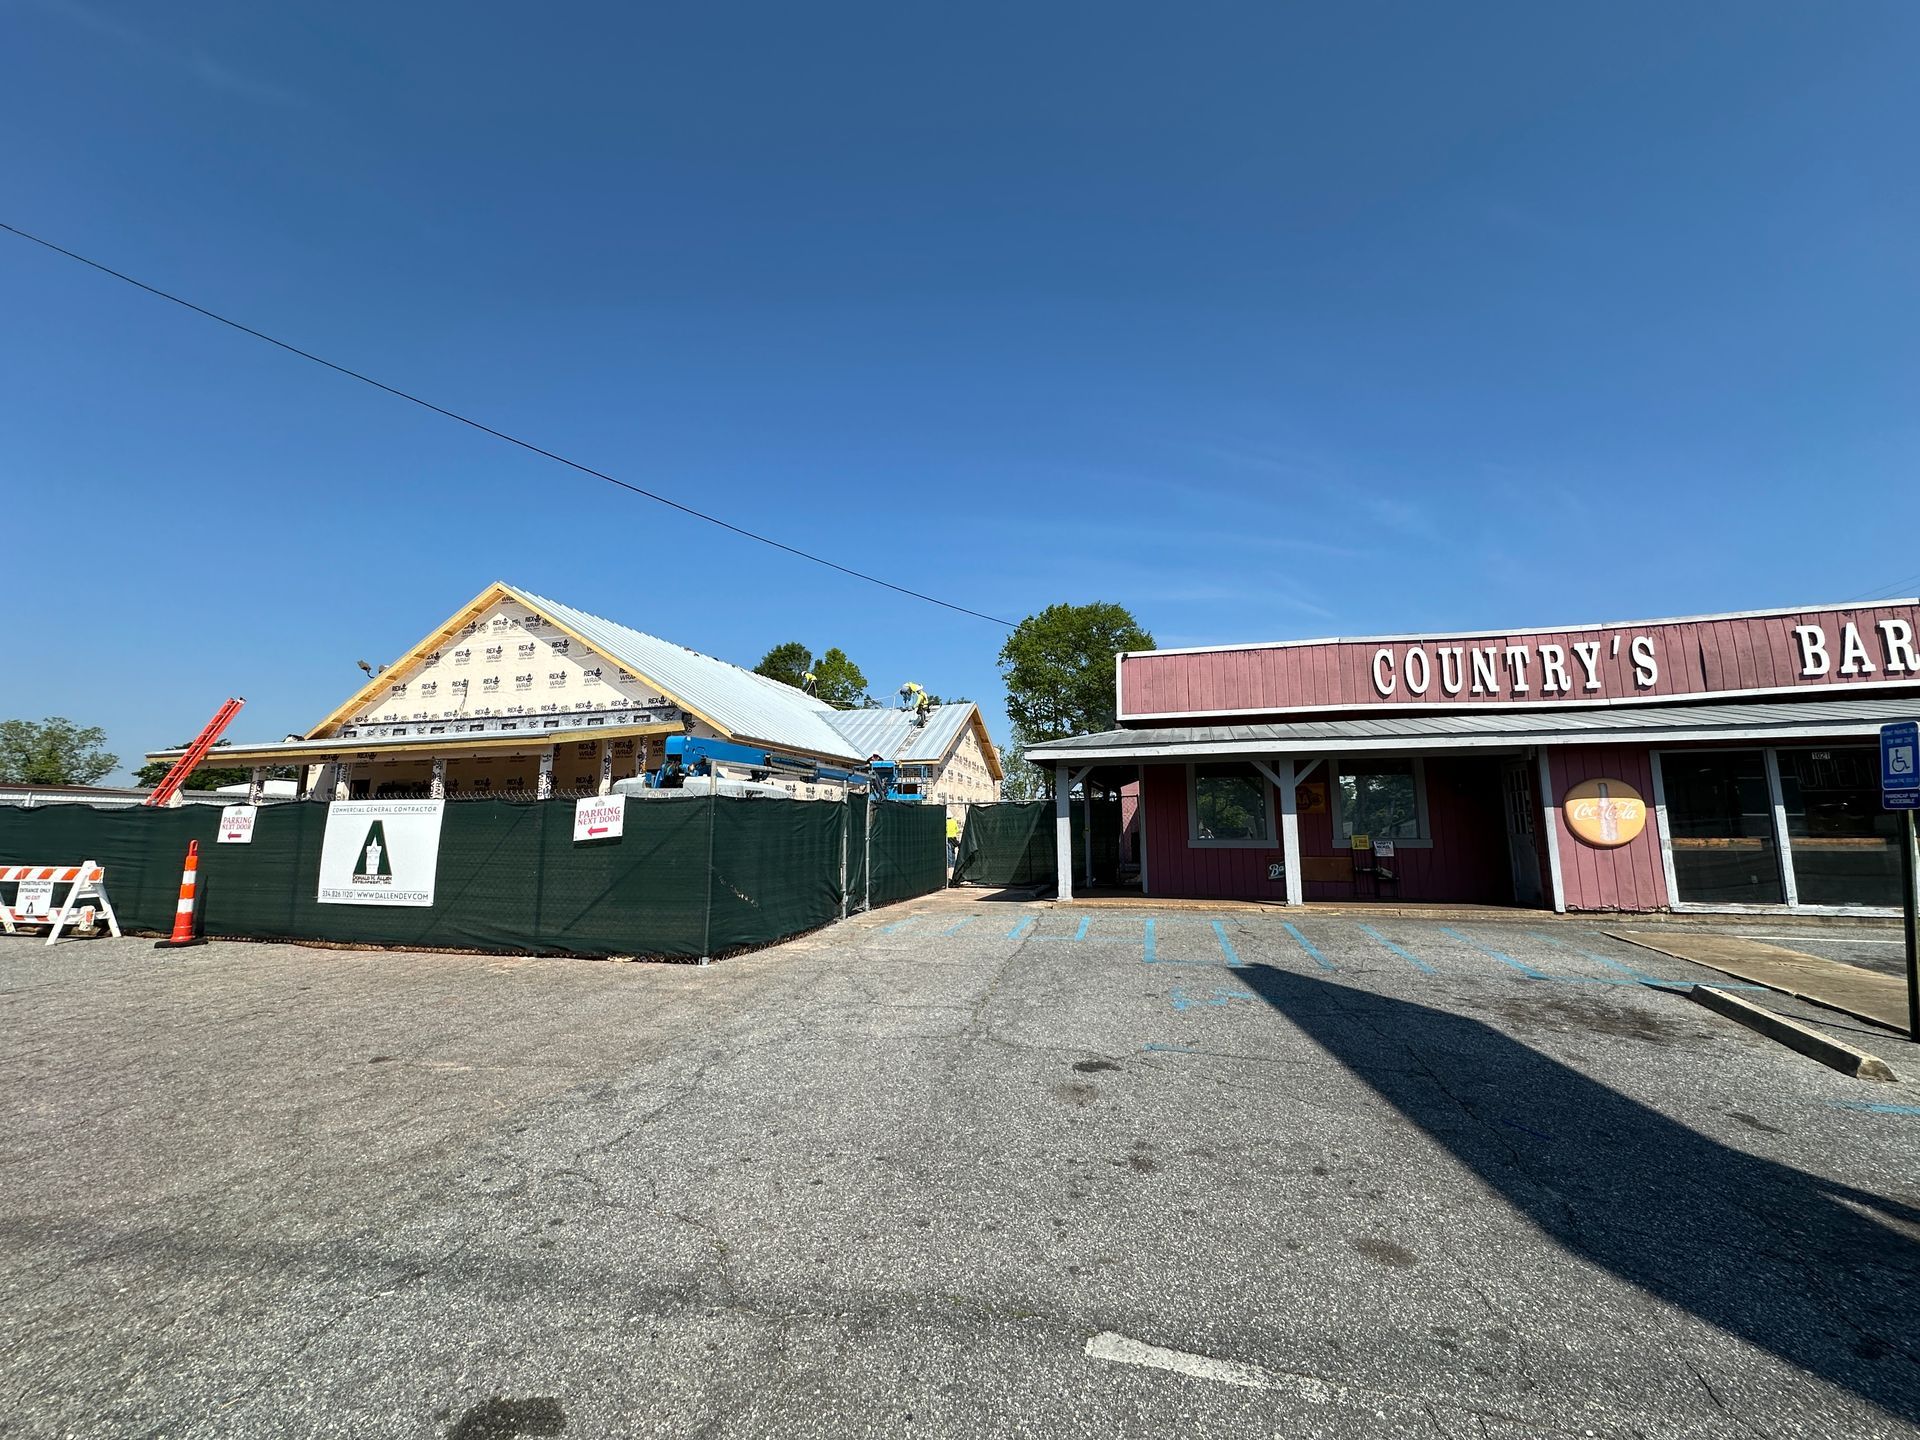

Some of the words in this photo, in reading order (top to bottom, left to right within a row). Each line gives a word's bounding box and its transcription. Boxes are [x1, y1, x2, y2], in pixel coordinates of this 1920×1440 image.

[1372, 634, 1659, 696] COUNTRY'S
[1796, 619, 1920, 677] BAR
[516, 675, 525, 683] REX
[394, 805, 437, 813] CONTRACTOR
[578, 807, 621, 818] PARKING
[224, 816, 252, 824] PARKING
[577, 817, 597, 826] NEXT
[599, 815, 621, 823] DOOR
